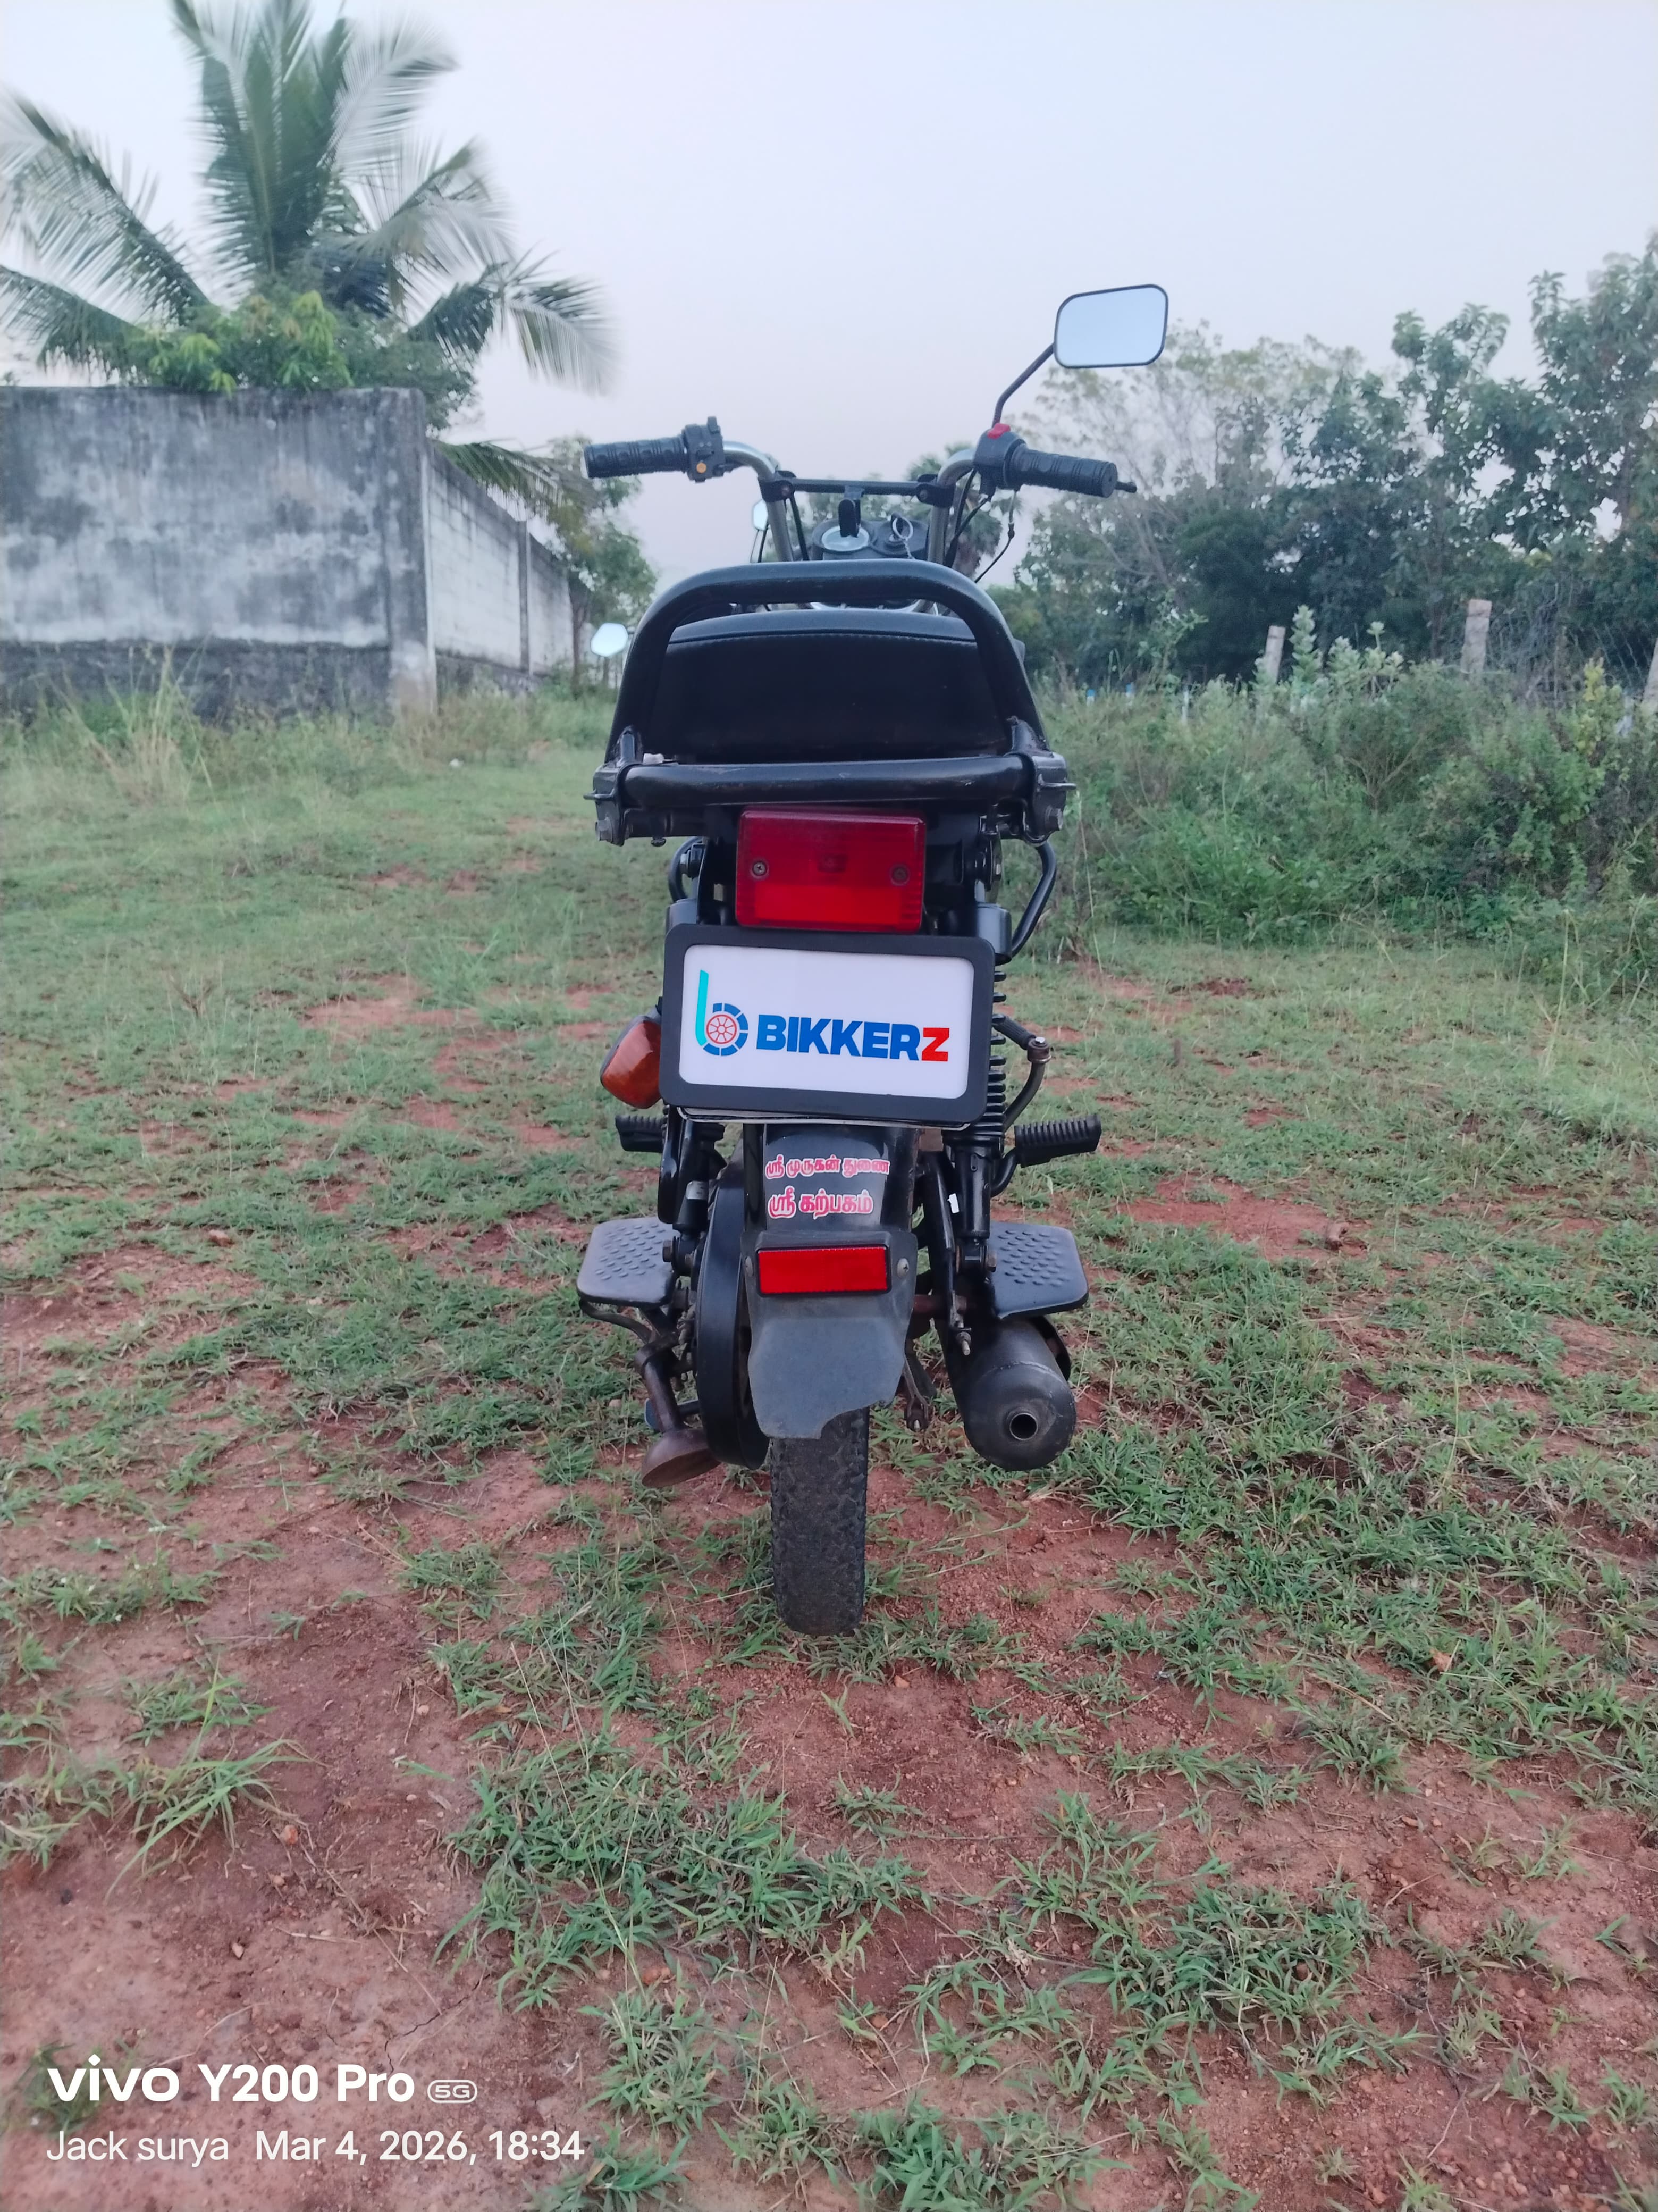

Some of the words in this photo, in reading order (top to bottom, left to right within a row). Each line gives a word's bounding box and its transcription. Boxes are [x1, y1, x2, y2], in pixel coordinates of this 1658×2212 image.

[756, 1013, 950, 1062] BIKKERZ
[786, 1154, 841, 1177] முருகன்
[842, 1158, 890, 1178] துணை
[799, 1188, 873, 1220] கற்பகம்
